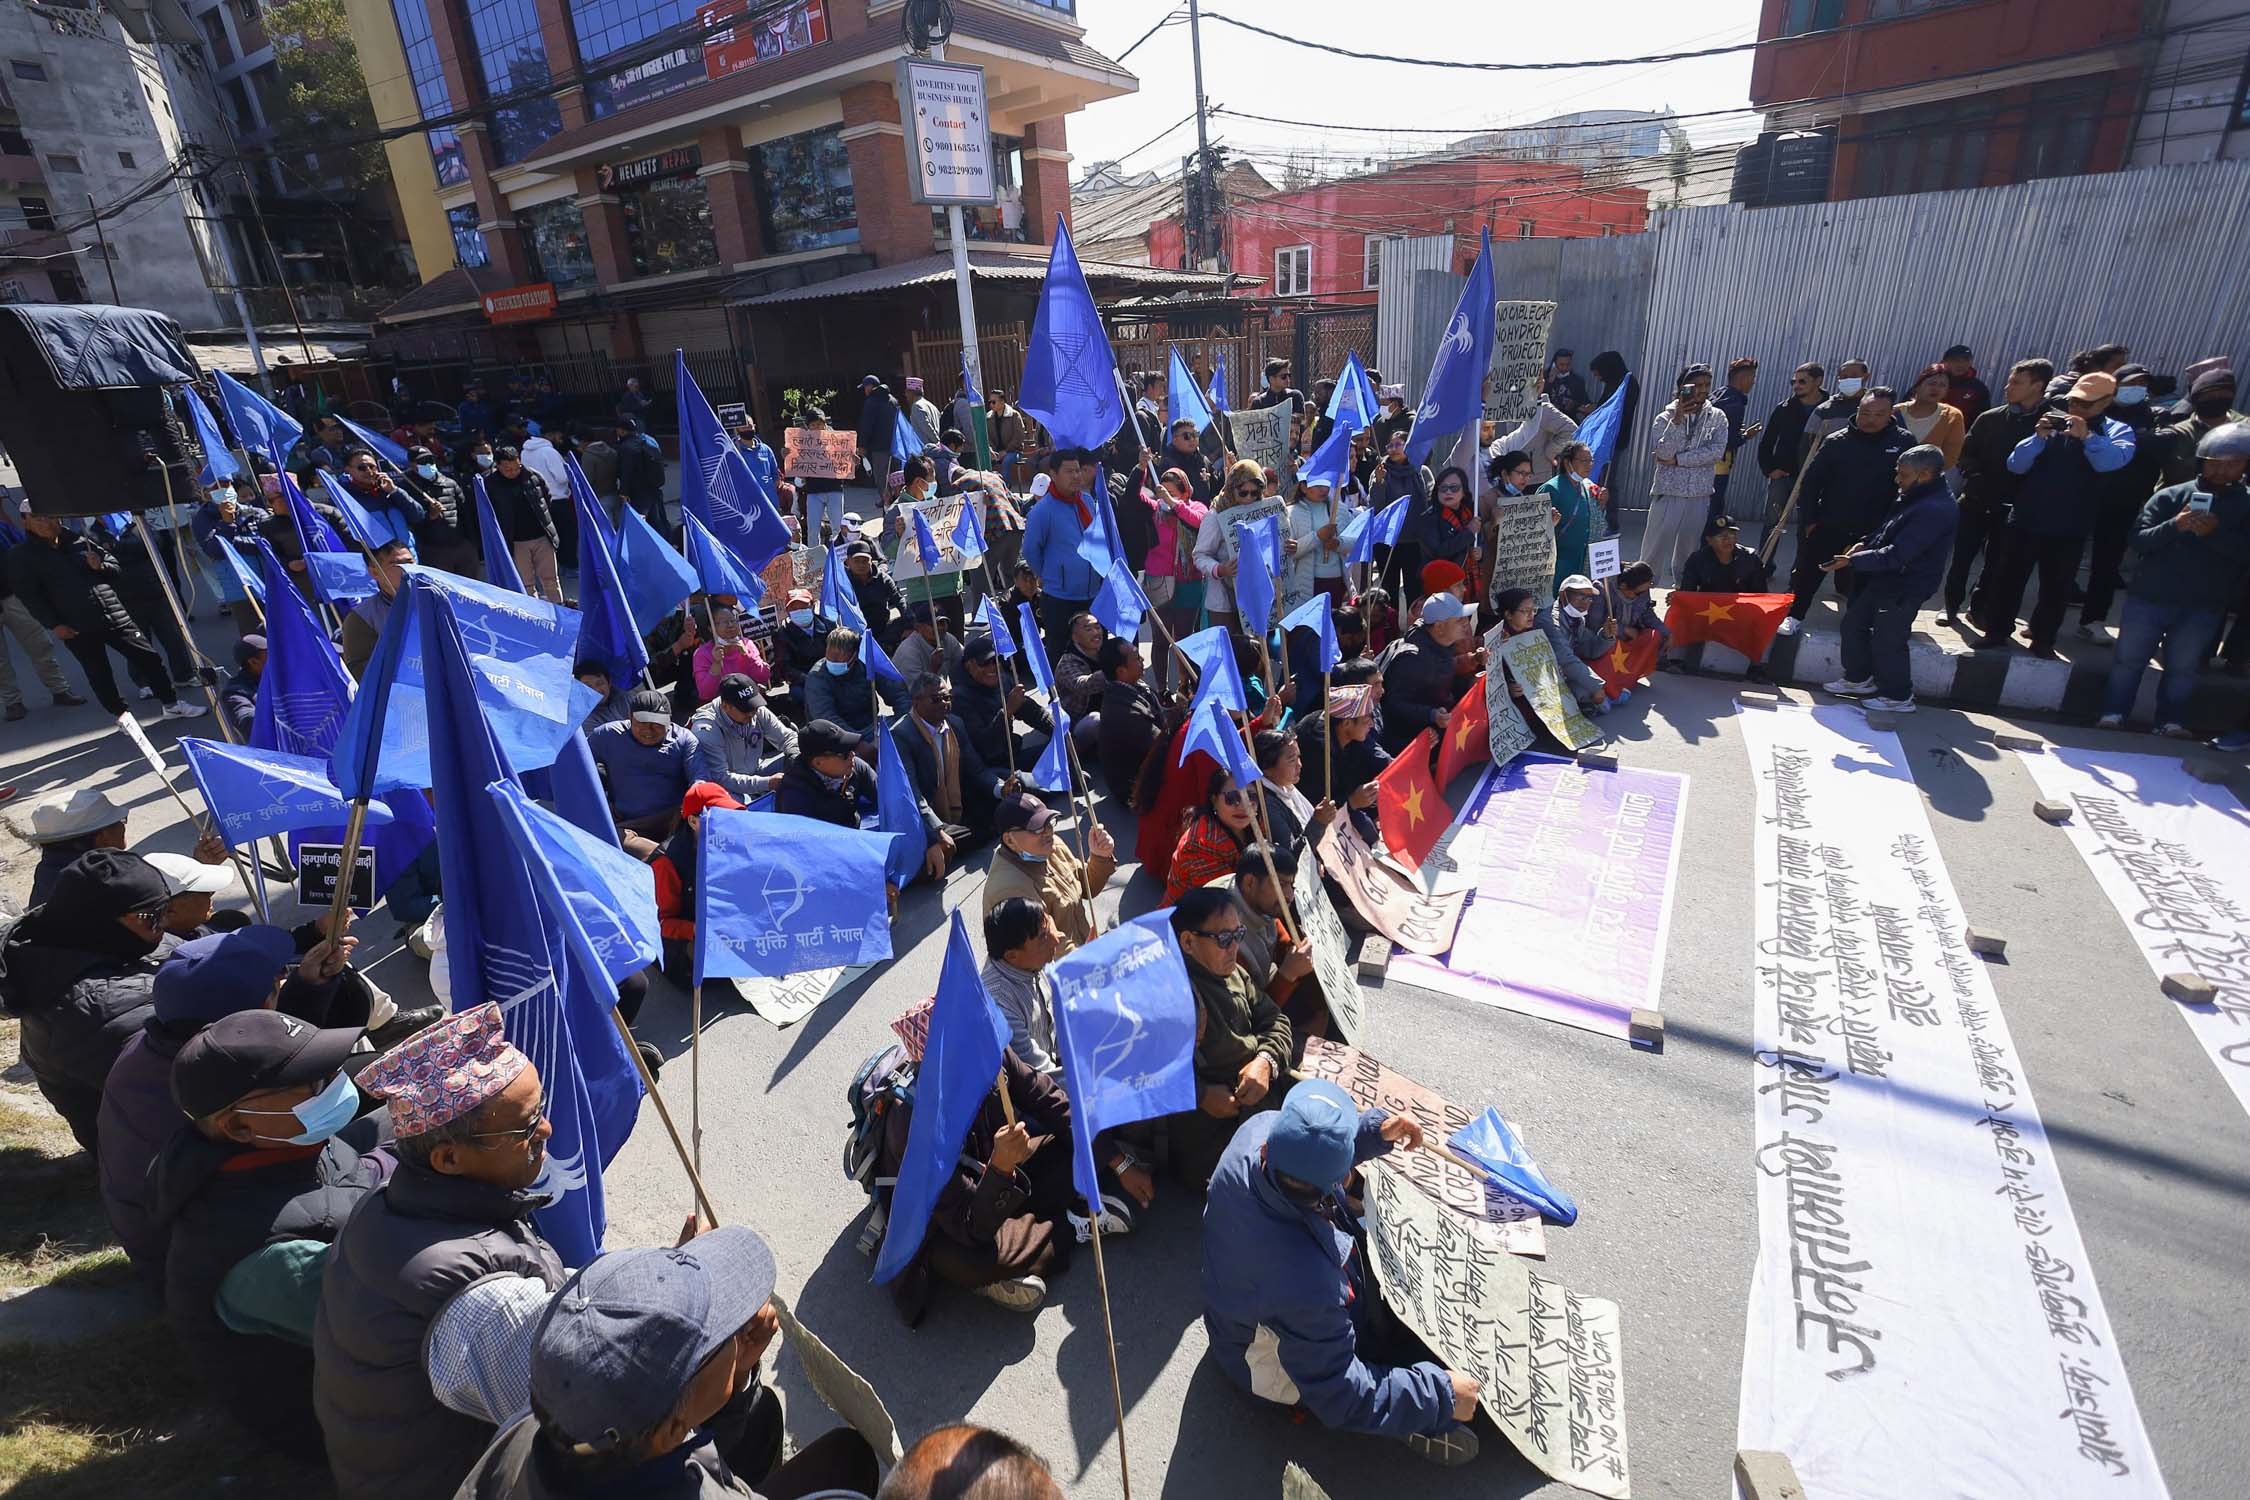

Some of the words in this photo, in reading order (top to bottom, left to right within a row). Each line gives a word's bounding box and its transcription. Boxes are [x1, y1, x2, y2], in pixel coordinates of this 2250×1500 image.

[915, 79, 956, 92] ADVERTISE
[956, 82, 977, 93] YOUR
[917, 91, 952, 103] BUSINESS
[952, 94, 974, 105] HERE
[932, 116, 967, 130] Contact
[619, 158, 657, 182] HELMETS
[662, 151, 691, 170] NEPAL
[1496, 308, 1507, 322] NO
[1495, 328, 1506, 344] NO
[1506, 324, 1542, 342] HYDRO
[1501, 341, 1545, 361] PROJECTS
[1493, 379, 1527, 394] SACRED
[1499, 393, 1524, 409] LAND
[1516, 407, 1537, 419] LAND
[487, 671, 513, 689] पार्टी
[515, 679, 545, 701] नेपाल
[738, 686, 755, 699] NSF
[258, 803, 290, 822] मुक्ति
[296, 799, 324, 814] पार्टी
[328, 799, 355, 812] नेपा
[2070, 791, 2145, 846] नाममा
[301, 852, 328, 868] सम्पूर्ण
[1776, 833, 1813, 880] नाममा
[1358, 867, 1389, 906] GO
[1397, 894, 1449, 944] BACK
[1757, 879, 1826, 962] विकासको
[754, 929, 789, 957] मुक्ति
[794, 926, 825, 946] पार्टी
[830, 923, 864, 943] नेपाल
[1839, 1000, 1873, 1016] र
[1826, 1013, 1894, 1079] प्रकृति
[1753, 1045, 1841, 1125] गोली
[1755, 1131, 1882, 1383] जनतामाथि
[1592, 1329, 1615, 1366] CAR
[1595, 1367, 1617, 1424] CABLE
